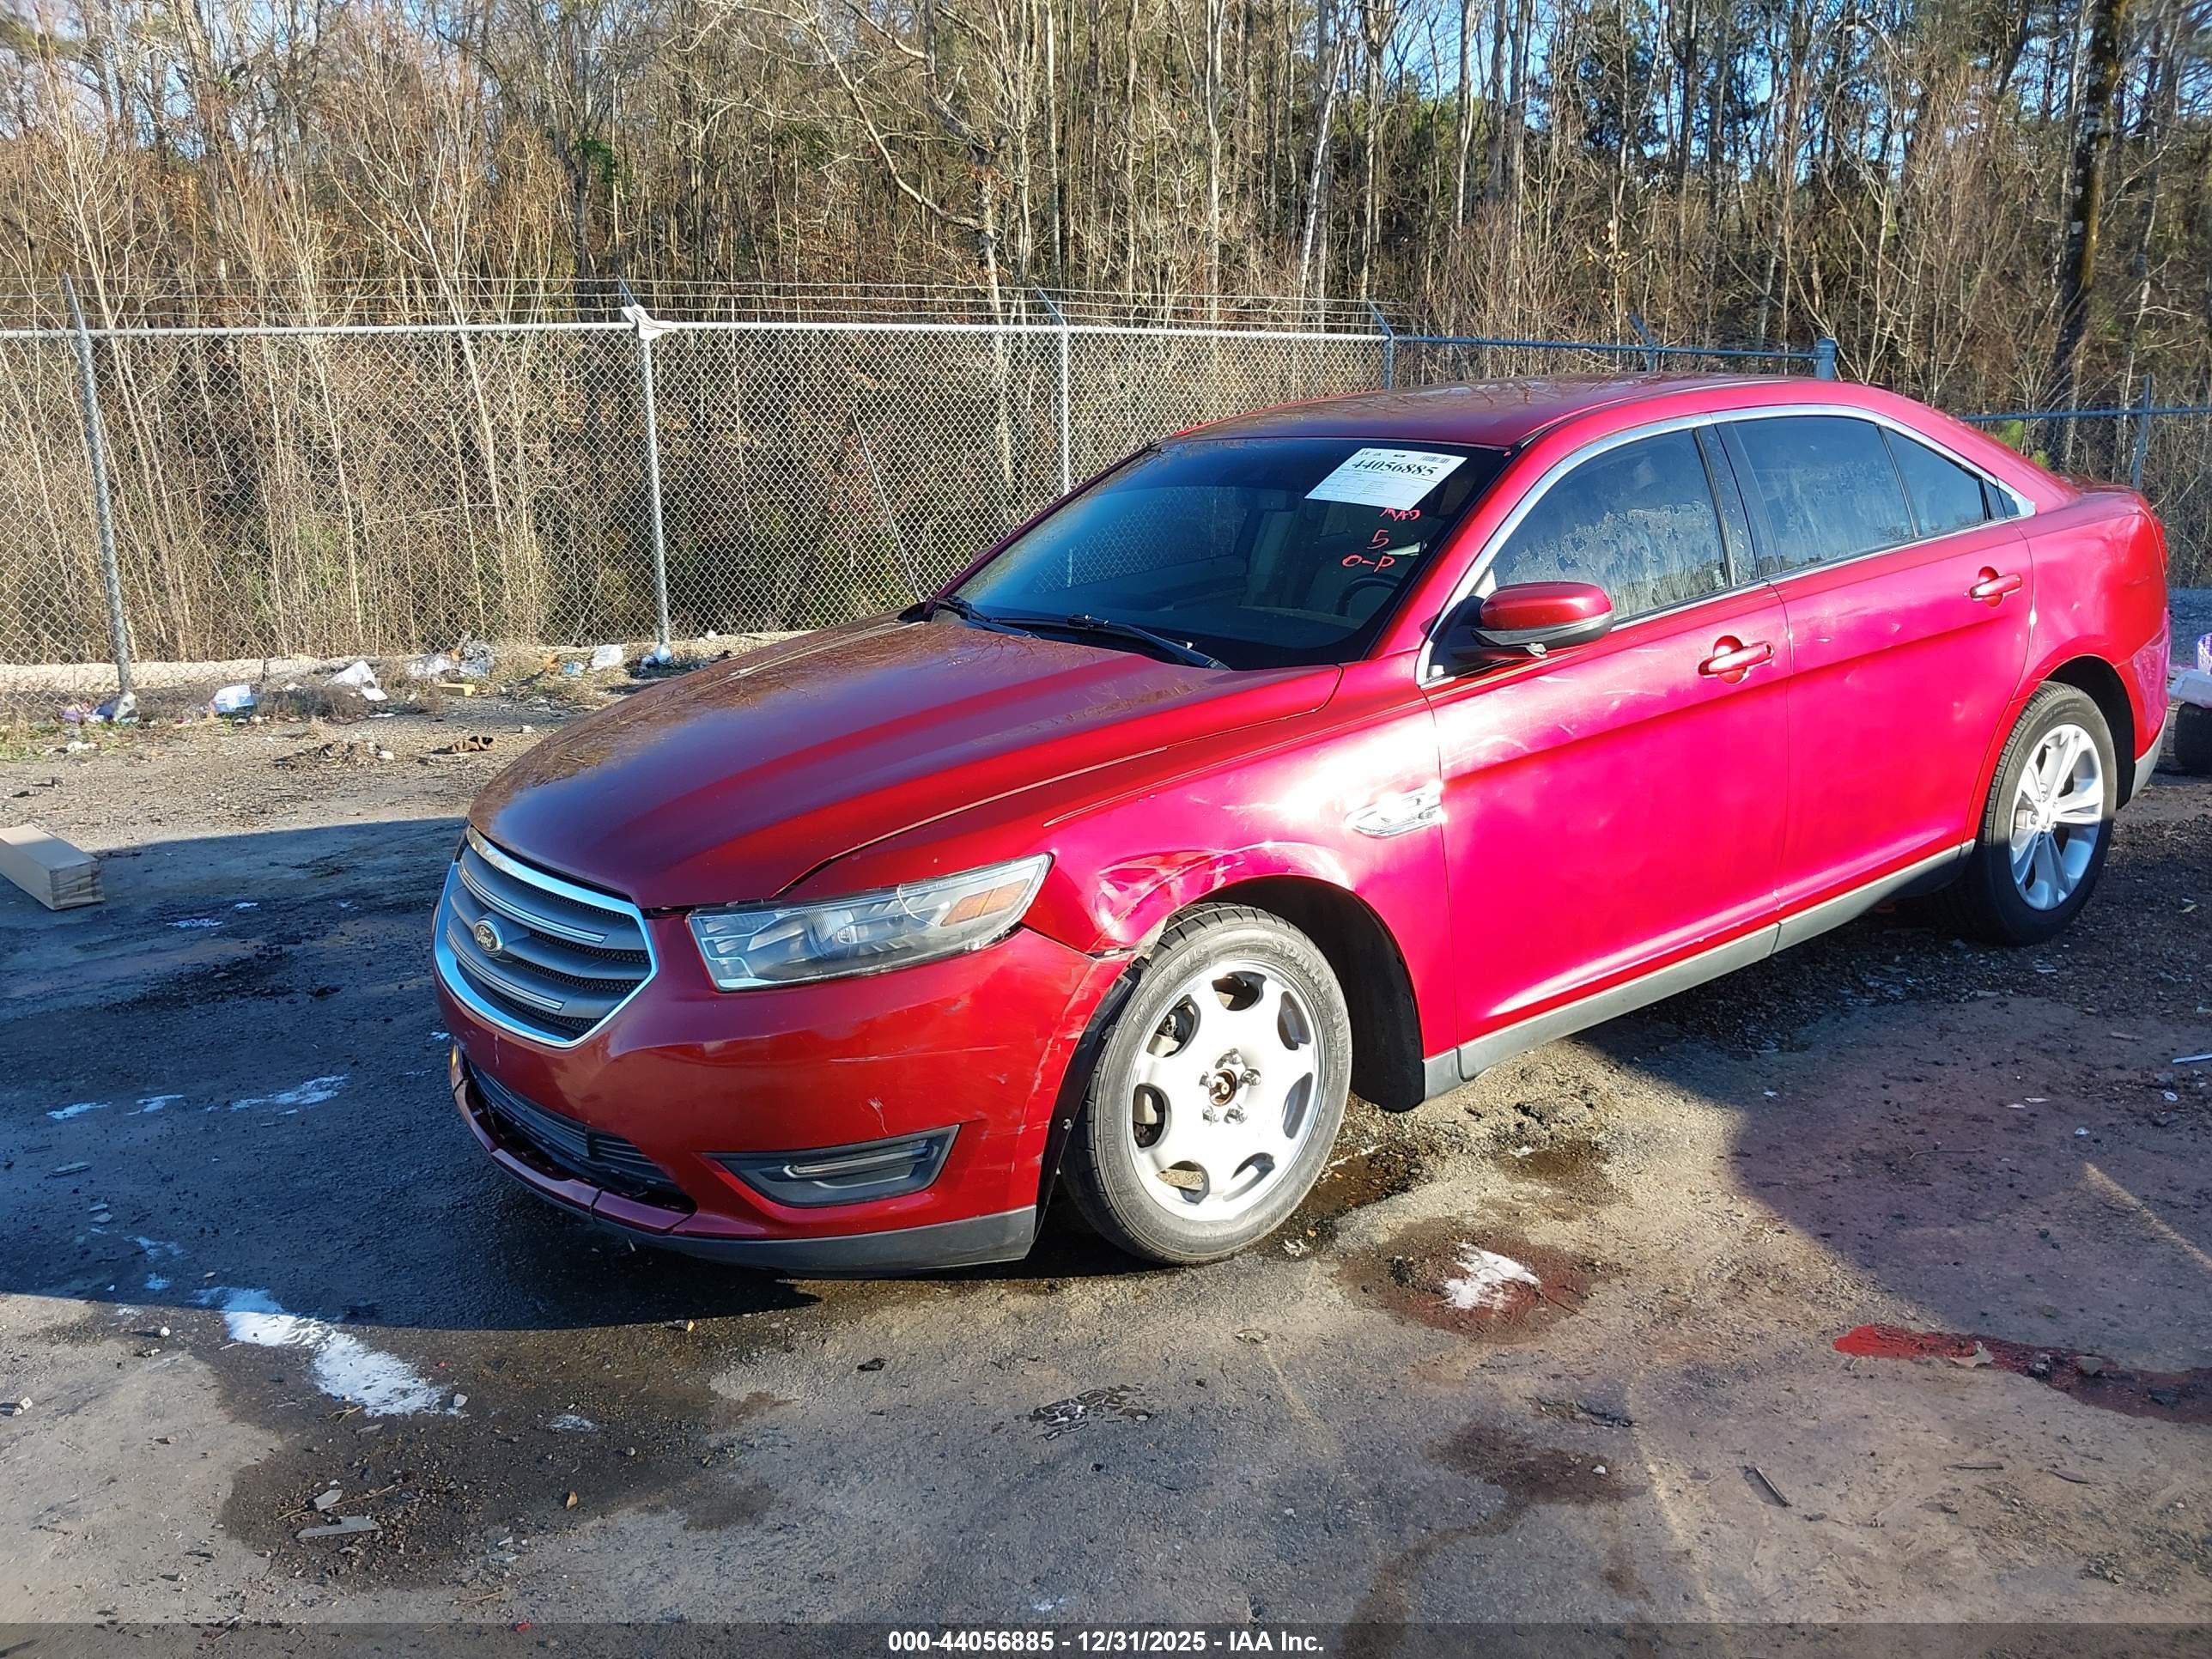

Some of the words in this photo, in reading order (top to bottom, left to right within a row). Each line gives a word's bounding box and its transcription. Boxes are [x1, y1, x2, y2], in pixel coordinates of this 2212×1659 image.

[1352, 459, 1438, 476] 44056885
[1366, 529, 1389, 550] 5
[477, 926, 494, 947] Ford
[1269, 934, 1334, 1000] SPARE
[1132, 944, 1210, 1030] MAXXIS
